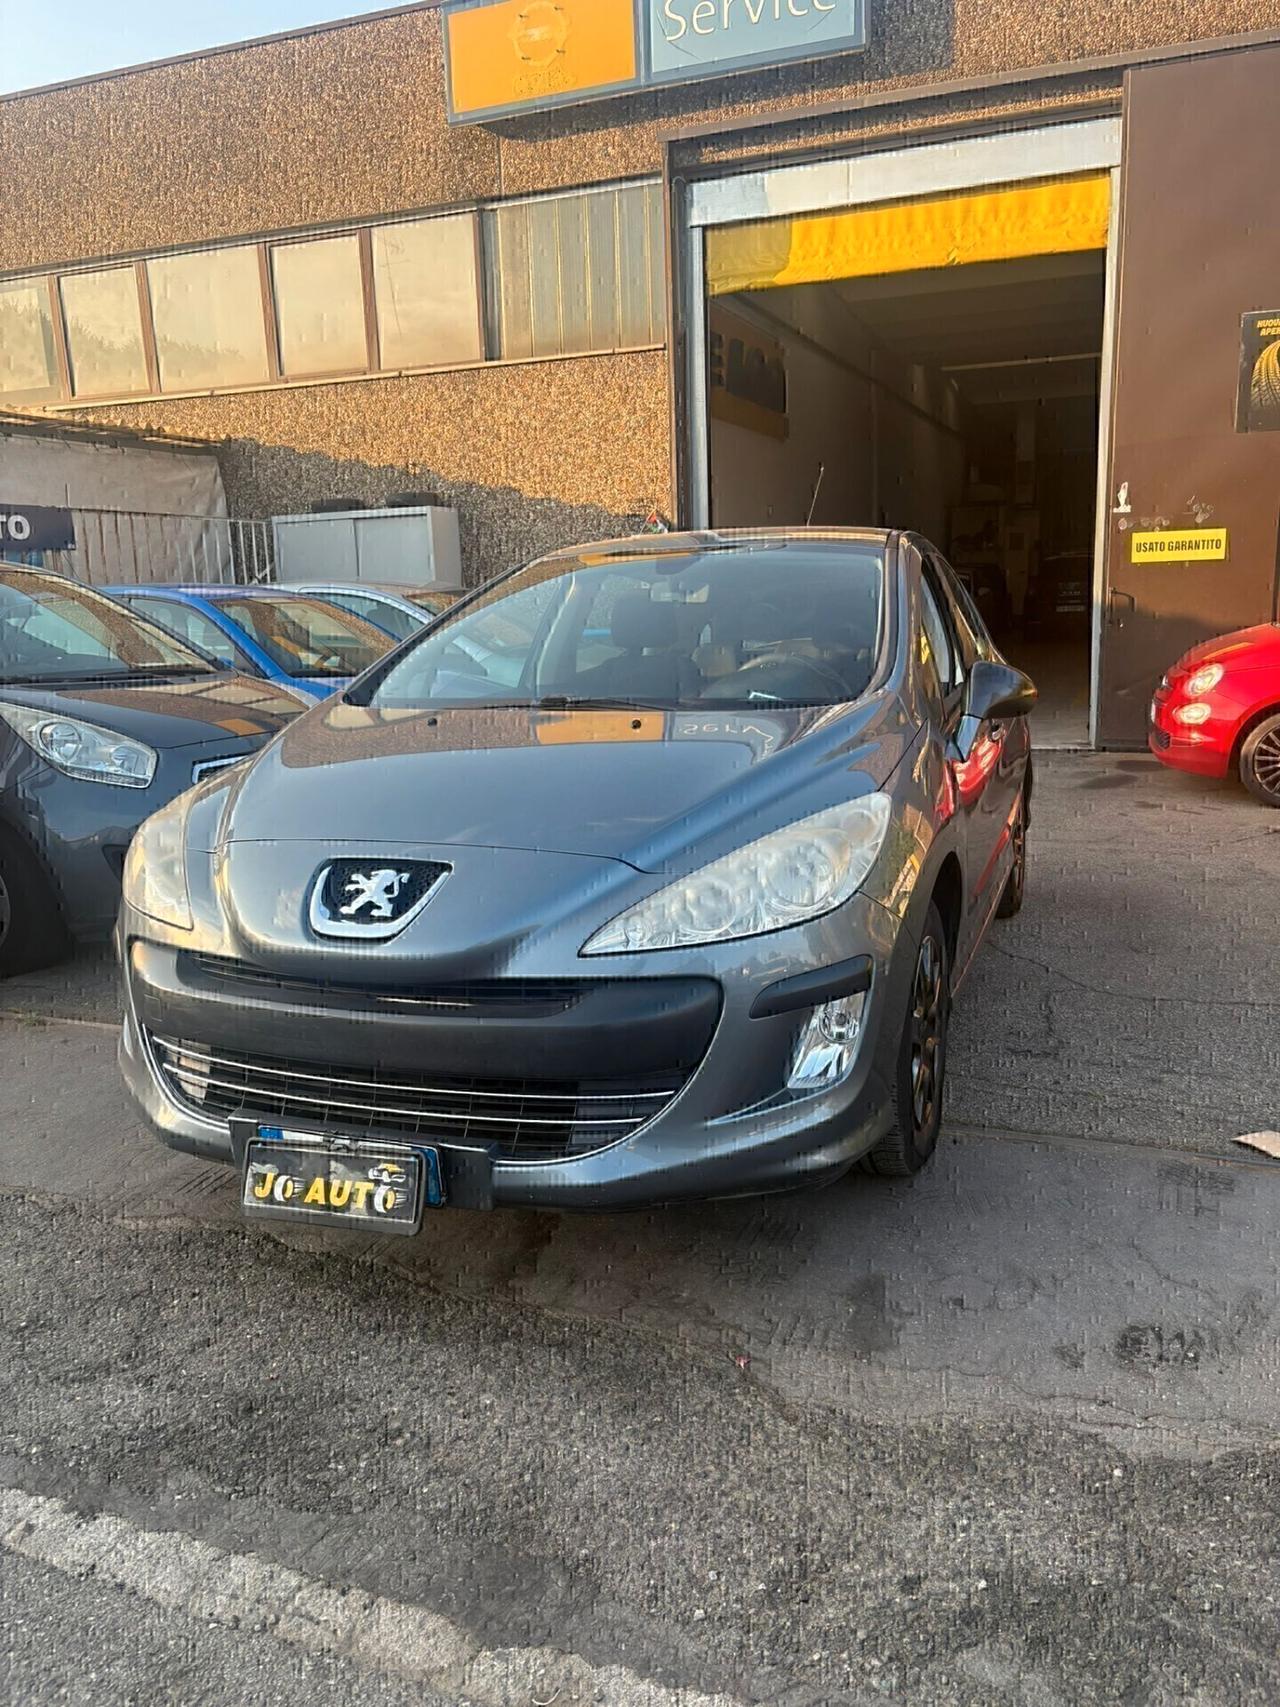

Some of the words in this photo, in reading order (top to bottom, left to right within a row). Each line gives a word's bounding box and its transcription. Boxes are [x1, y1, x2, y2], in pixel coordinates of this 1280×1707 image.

[1136, 541, 1165, 553] USATO
[1167, 539, 1222, 551] GARANTITO
[254, 1172, 296, 1202] JO
[304, 1177, 398, 1213] AUTO
